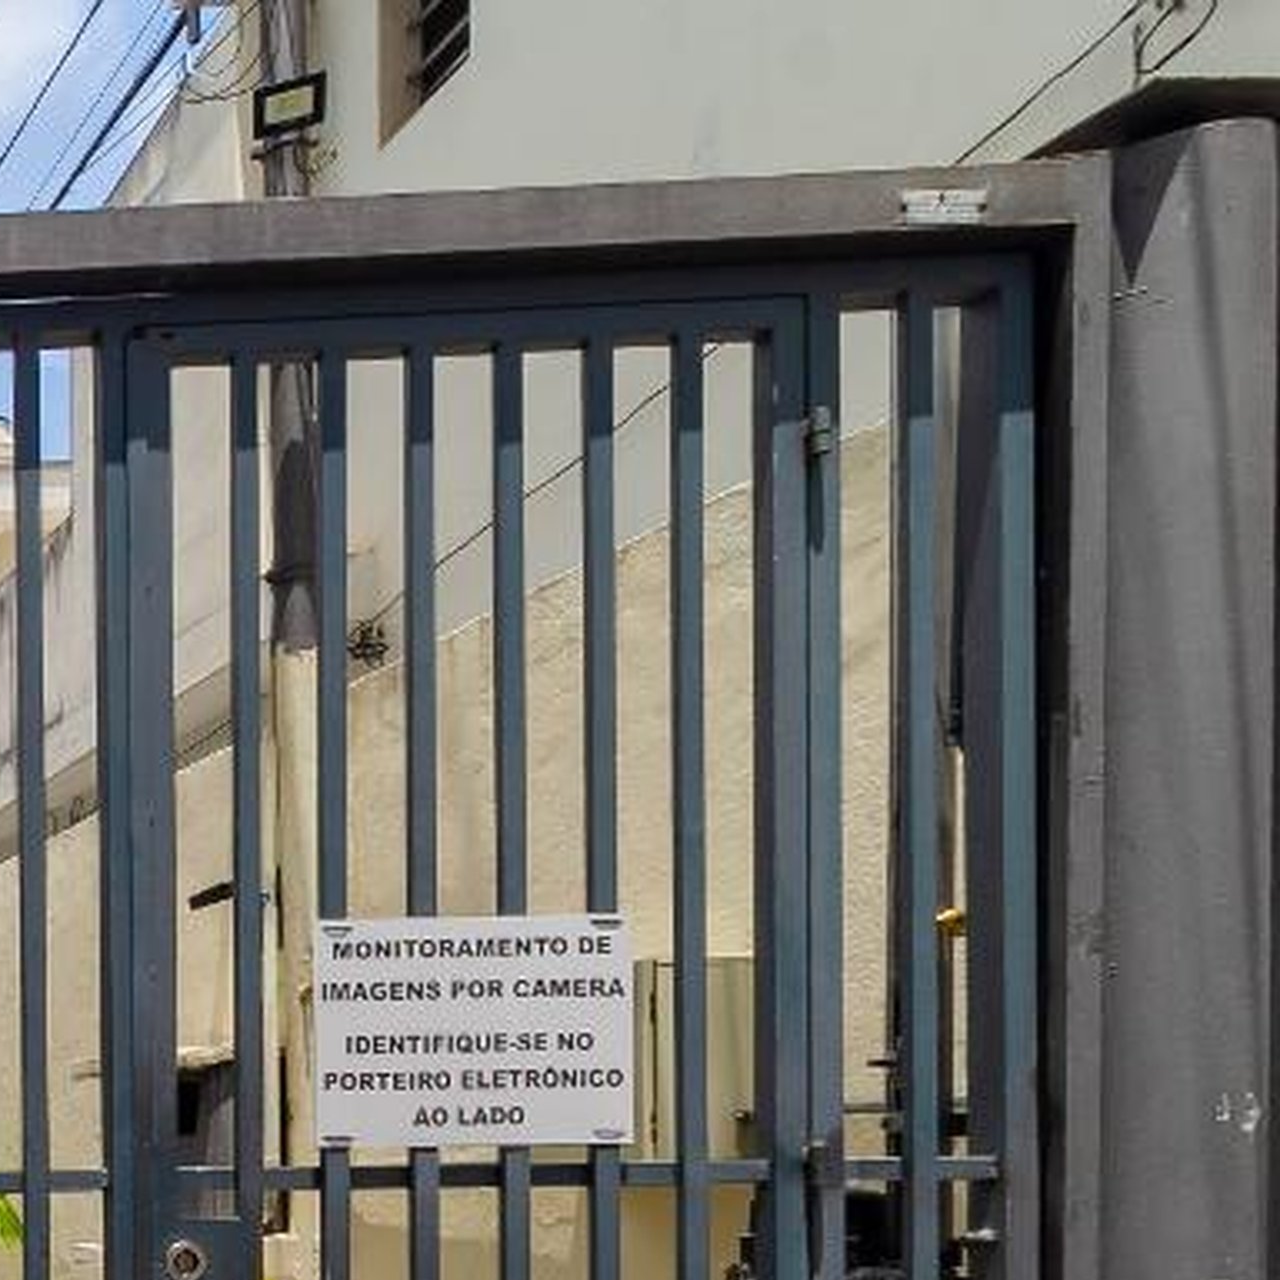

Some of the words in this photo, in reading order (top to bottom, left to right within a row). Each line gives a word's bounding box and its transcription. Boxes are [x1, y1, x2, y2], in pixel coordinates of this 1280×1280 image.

[331, 937, 568, 961] MONITORAMENTO
[577, 935, 612, 955] DE
[321, 981, 441, 1002] IMAGENS
[451, 979, 504, 1000] POR
[513, 977, 626, 998] CAMERA
[345, 1032, 549, 1055] IDENTIFIQUE-SE
[556, 1032, 595, 1051] NO
[323, 1071, 451, 1092] PORTEIRO
[461, 1067, 625, 1090] ELETRÔNICO
[413, 1107, 448, 1127] AO
[457, 1105, 525, 1126] LADO
